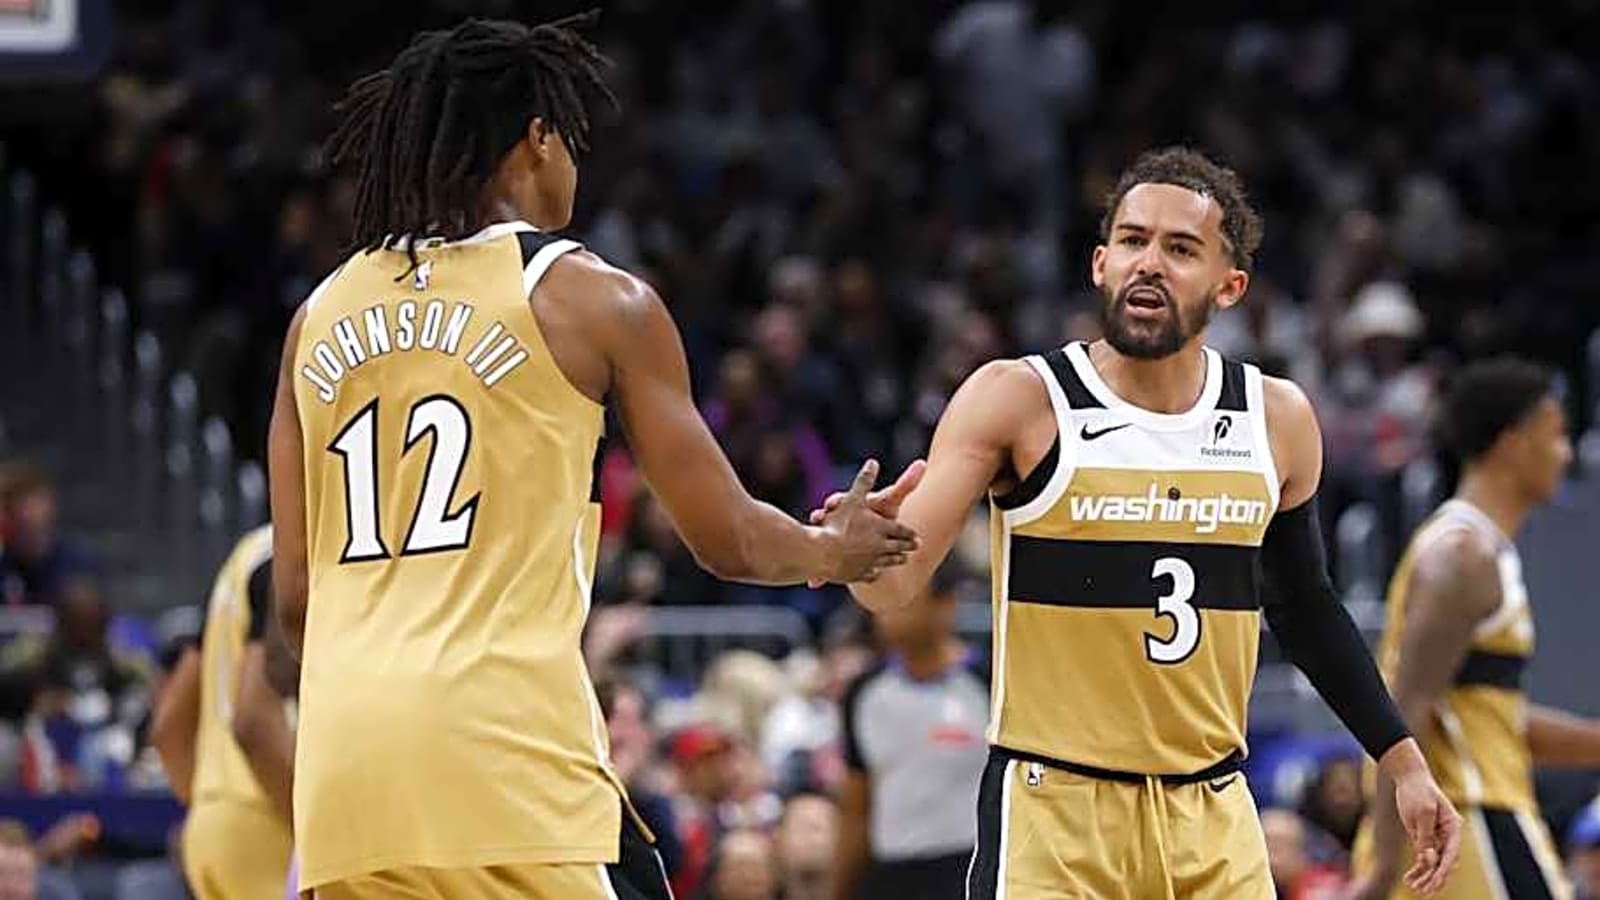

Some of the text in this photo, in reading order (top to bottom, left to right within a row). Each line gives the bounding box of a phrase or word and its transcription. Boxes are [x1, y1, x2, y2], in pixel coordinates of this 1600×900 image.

[302, 299, 529, 404] JOHNSON III
[326, 393, 482, 565] 12
[1200, 446, 1251, 458] Robinhood
[1070, 482, 1266, 533] washington
[1144, 554, 1202, 664] 3
